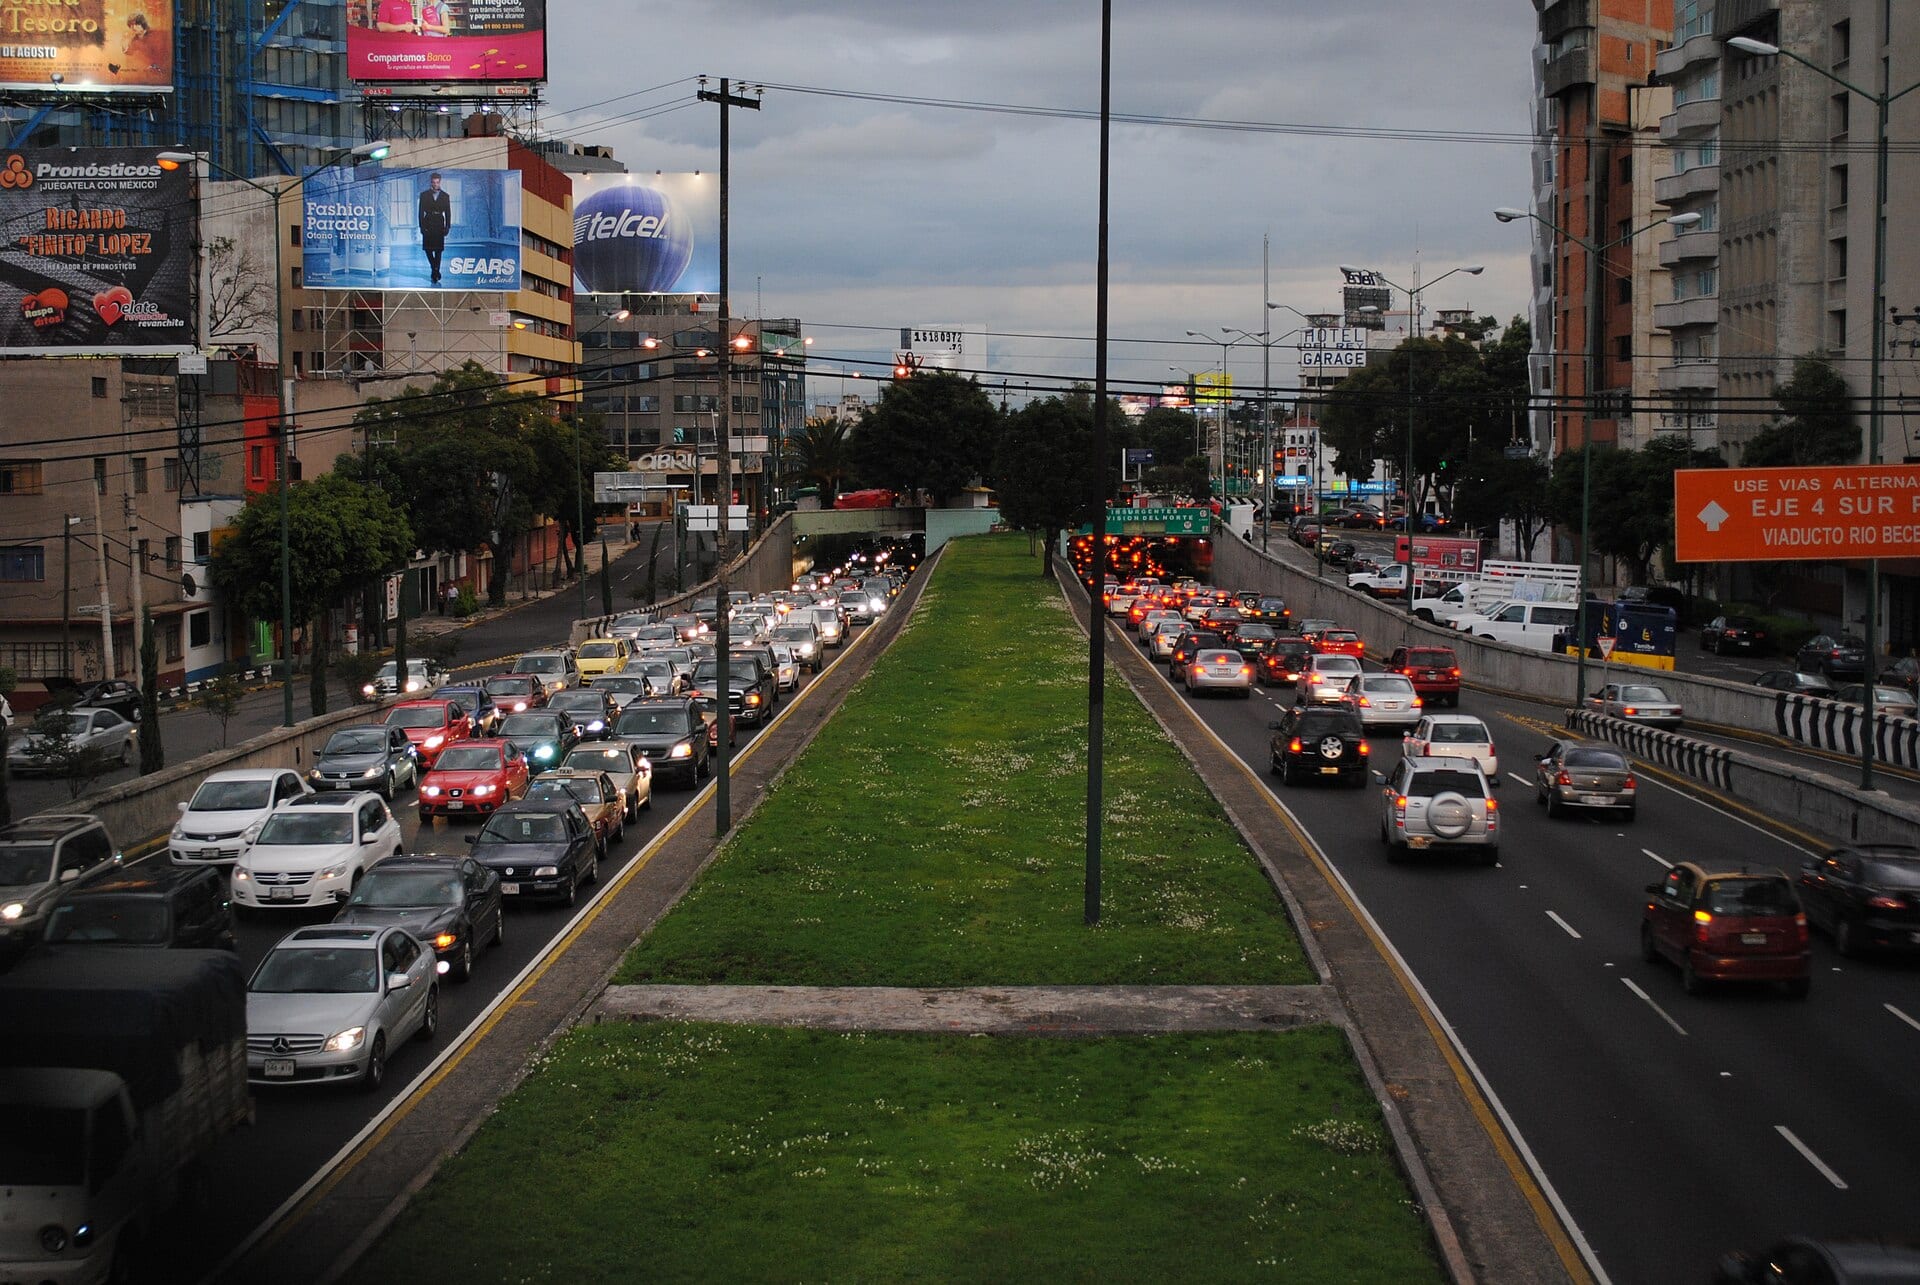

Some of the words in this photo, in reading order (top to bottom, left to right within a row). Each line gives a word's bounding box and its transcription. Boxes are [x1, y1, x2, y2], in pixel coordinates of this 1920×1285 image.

[4, 7, 98, 32] Tesoro
[2, 46, 16, 58] DE
[17, 46, 57, 58] AGOSTO
[367, 53, 426, 64] Compartamos
[426, 52, 452, 62] Banco
[37, 163, 162, 177] Pronósticos
[97, 181, 117, 190] CON
[307, 203, 376, 216] Fashion
[307, 217, 370, 230] Parade
[587, 209, 669, 241] telcel
[340, 232, 376, 240] Invierno
[98, 233, 152, 255] LOPEZ
[449, 257, 516, 275] SEARS
[138, 319, 184, 327] revanchita
[1304, 328, 1364, 343] HOTEL
[1303, 352, 1365, 365] GARAGE
[1734, 480, 1768, 493] USE
[1779, 478, 1821, 491] VIAS
[1833, 475, 1920, 490] ALTERNA
[1752, 498, 1799, 517] EJE
[1811, 497, 1825, 516] 4
[1839, 495, 1895, 515] SUR
[1763, 527, 1844, 546] VIADUCTO
[1849, 526, 1876, 545] RIO
